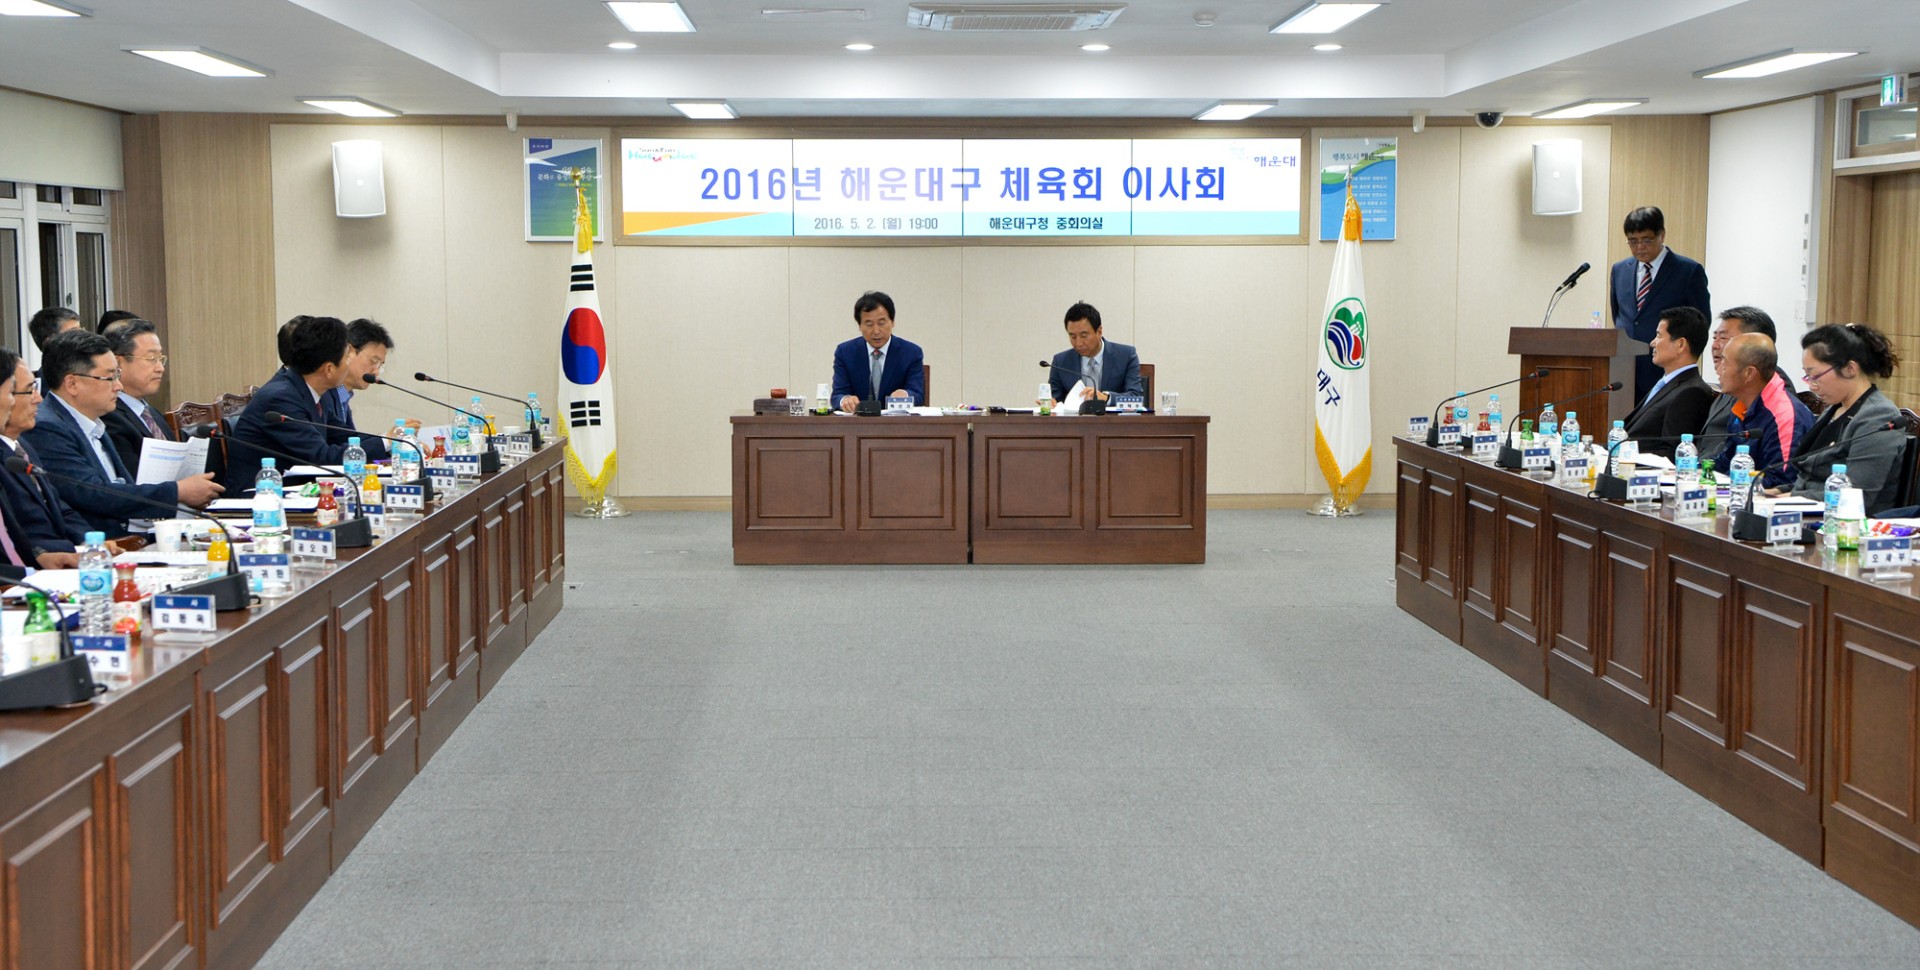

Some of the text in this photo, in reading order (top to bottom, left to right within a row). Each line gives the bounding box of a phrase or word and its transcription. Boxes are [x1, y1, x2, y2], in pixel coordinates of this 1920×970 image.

[1253, 154, 1297, 168] 해운대
[700, 166, 1225, 202] 2016년 해운대구 체육회 이사회
[814, 217, 844, 230] 2016.
[850, 217, 860, 230] 5.
[867, 217, 876, 230] 2.
[909, 217, 938, 230] 19:00
[989, 217, 1103, 230] 해운대구청 중회의실
